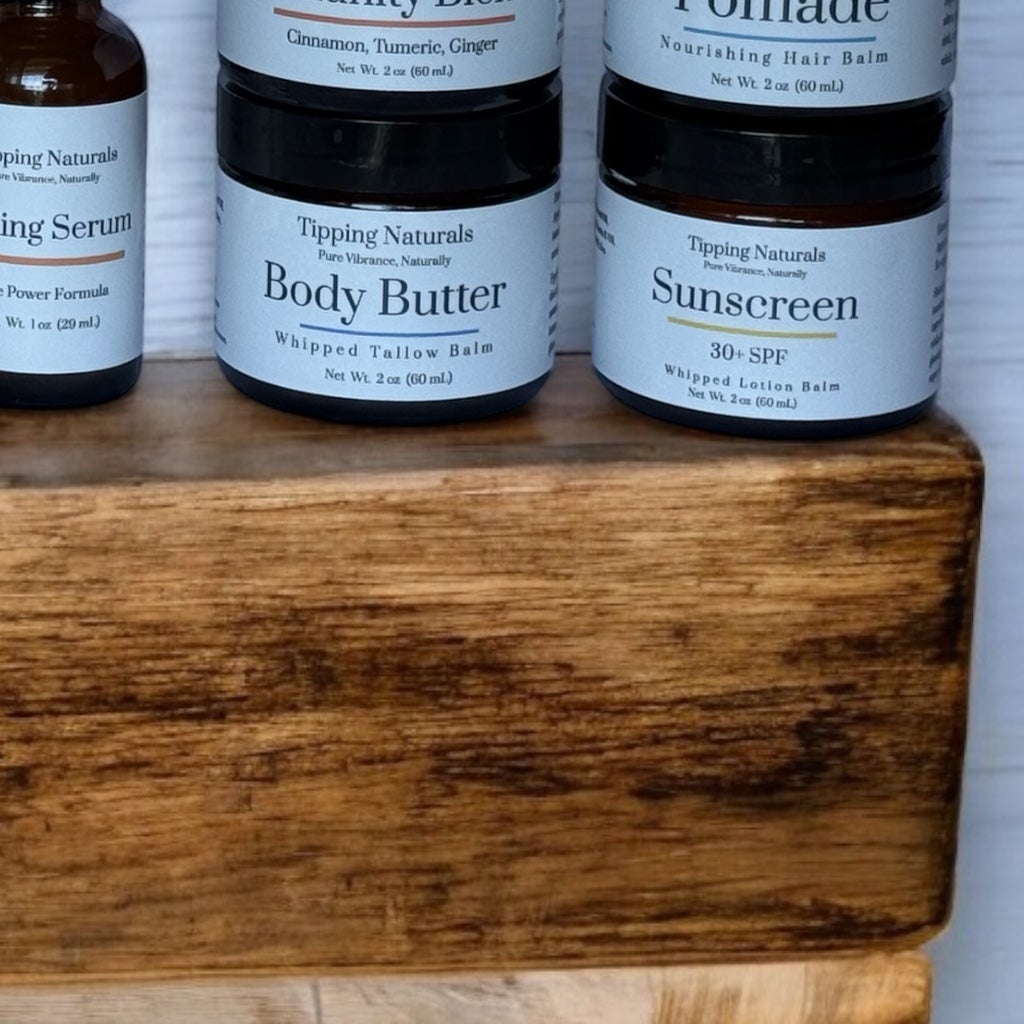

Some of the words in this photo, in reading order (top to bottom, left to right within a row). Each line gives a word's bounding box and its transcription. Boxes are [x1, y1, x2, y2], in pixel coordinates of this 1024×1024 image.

[287, 28, 369, 55] Cinnamon,
[373, 38, 445, 55] Tumeric,
[449, 37, 498, 55] Ginger
[660, 34, 772, 67] Nourishing
[784, 51, 830, 66] Hair
[842, 50, 888, 65] Balm
[336, 62, 355, 74] Net
[384, 65, 391, 76] 2
[710, 72, 733, 87] Net
[764, 77, 772, 90] 2
[775, 82, 789, 92] oz
[47, 146, 118, 167] Naturals
[51, 211, 131, 241] Serum
[297, 216, 378, 249] Tipping
[384, 224, 474, 245] Naturals
[318, 249, 344, 263] Pure
[346, 252, 398, 267] Vibrance,
[401, 255, 452, 267] Naturally
[688, 234, 750, 262] Tipping
[755, 244, 826, 263] Naturals
[7, 284, 51, 300] Power
[54, 284, 109, 300] Formula
[264, 260, 367, 325] Body
[378, 277, 507, 317] Butter
[652, 267, 859, 322] Sunscreen
[38, 321, 51, 330] oz
[275, 330, 358, 357] Whipped
[370, 344, 438, 359] Tallow
[449, 341, 494, 357] Balm
[748, 347, 788, 366] SPF
[325, 368, 345, 382] Net
[376, 372, 385, 384] 2
[387, 375, 400, 385] oz
[664, 363, 731, 387] Whipped
[739, 377, 793, 392] Lotion
[802, 380, 841, 392] Balm
[687, 386, 705, 400] Net
[730, 392, 738, 404] 2
